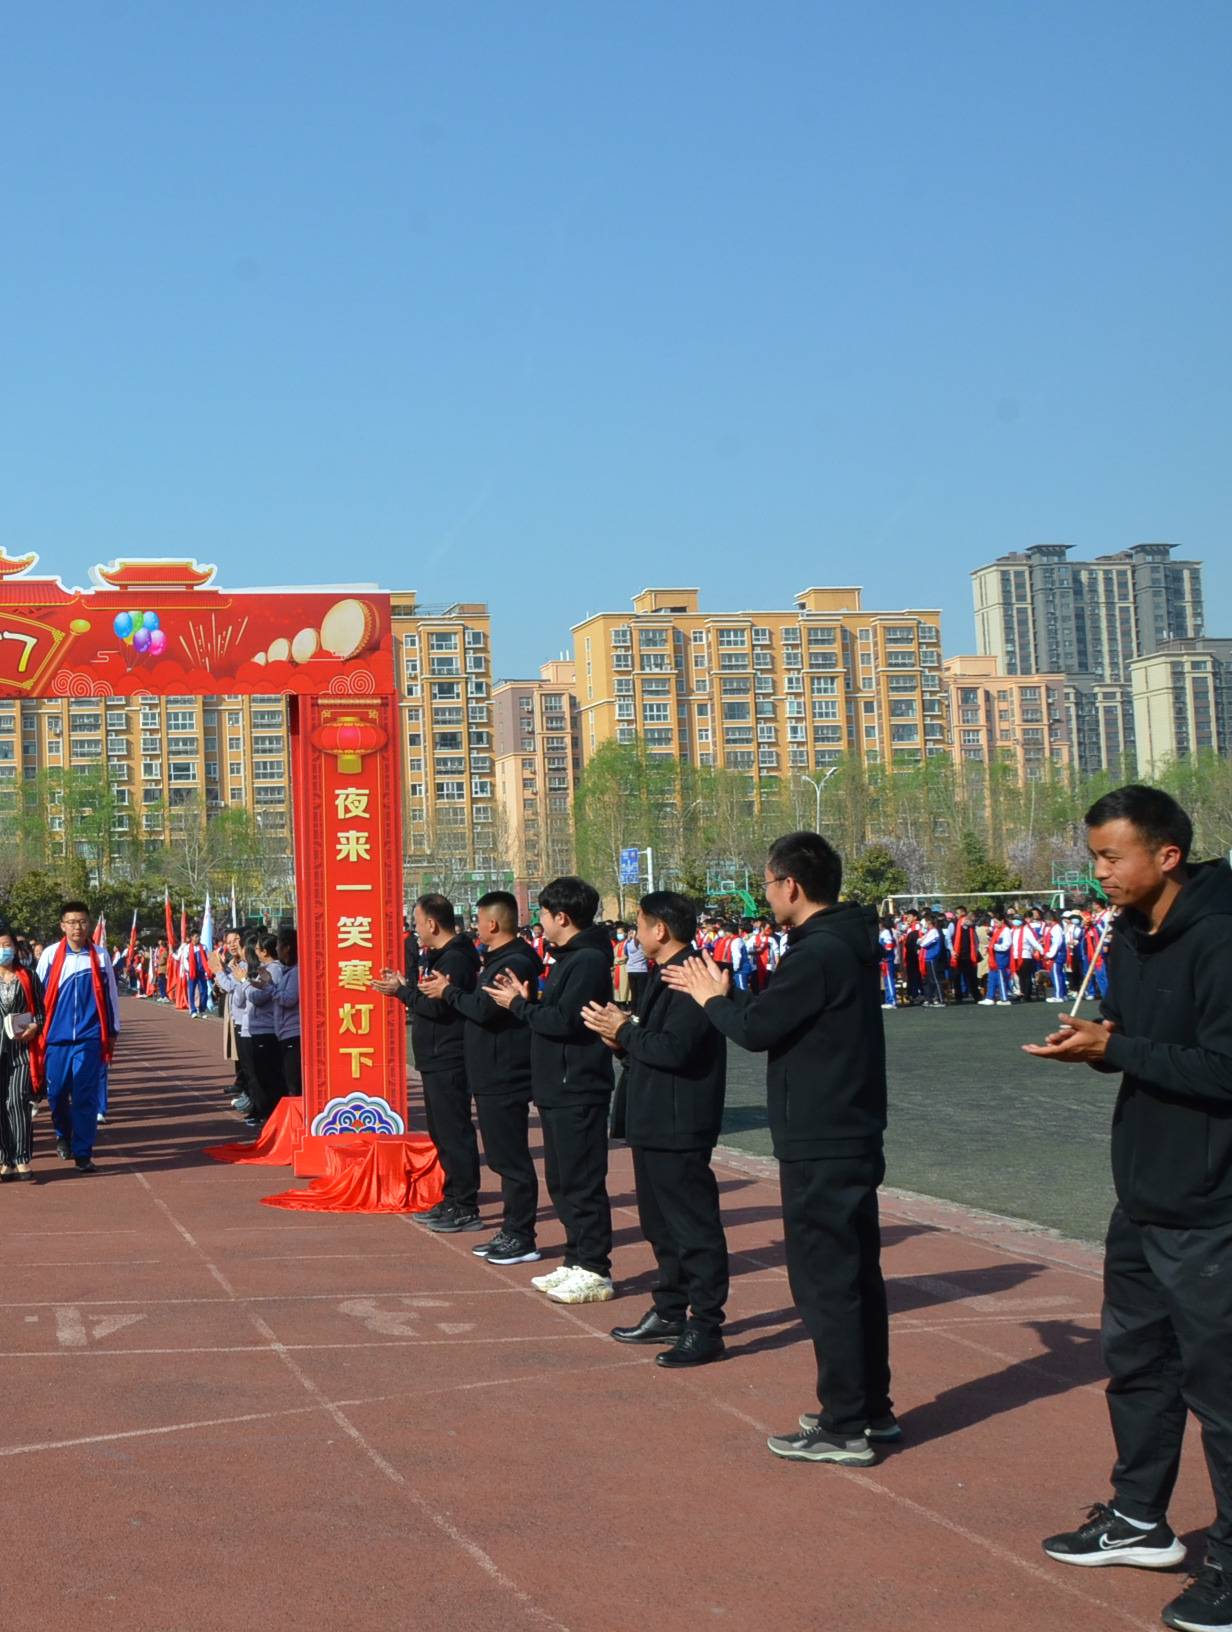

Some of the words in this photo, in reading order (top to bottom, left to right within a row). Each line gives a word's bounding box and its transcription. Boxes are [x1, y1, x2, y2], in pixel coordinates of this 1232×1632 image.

[334, 787, 375, 1079] 夜来一笑寒灯下
